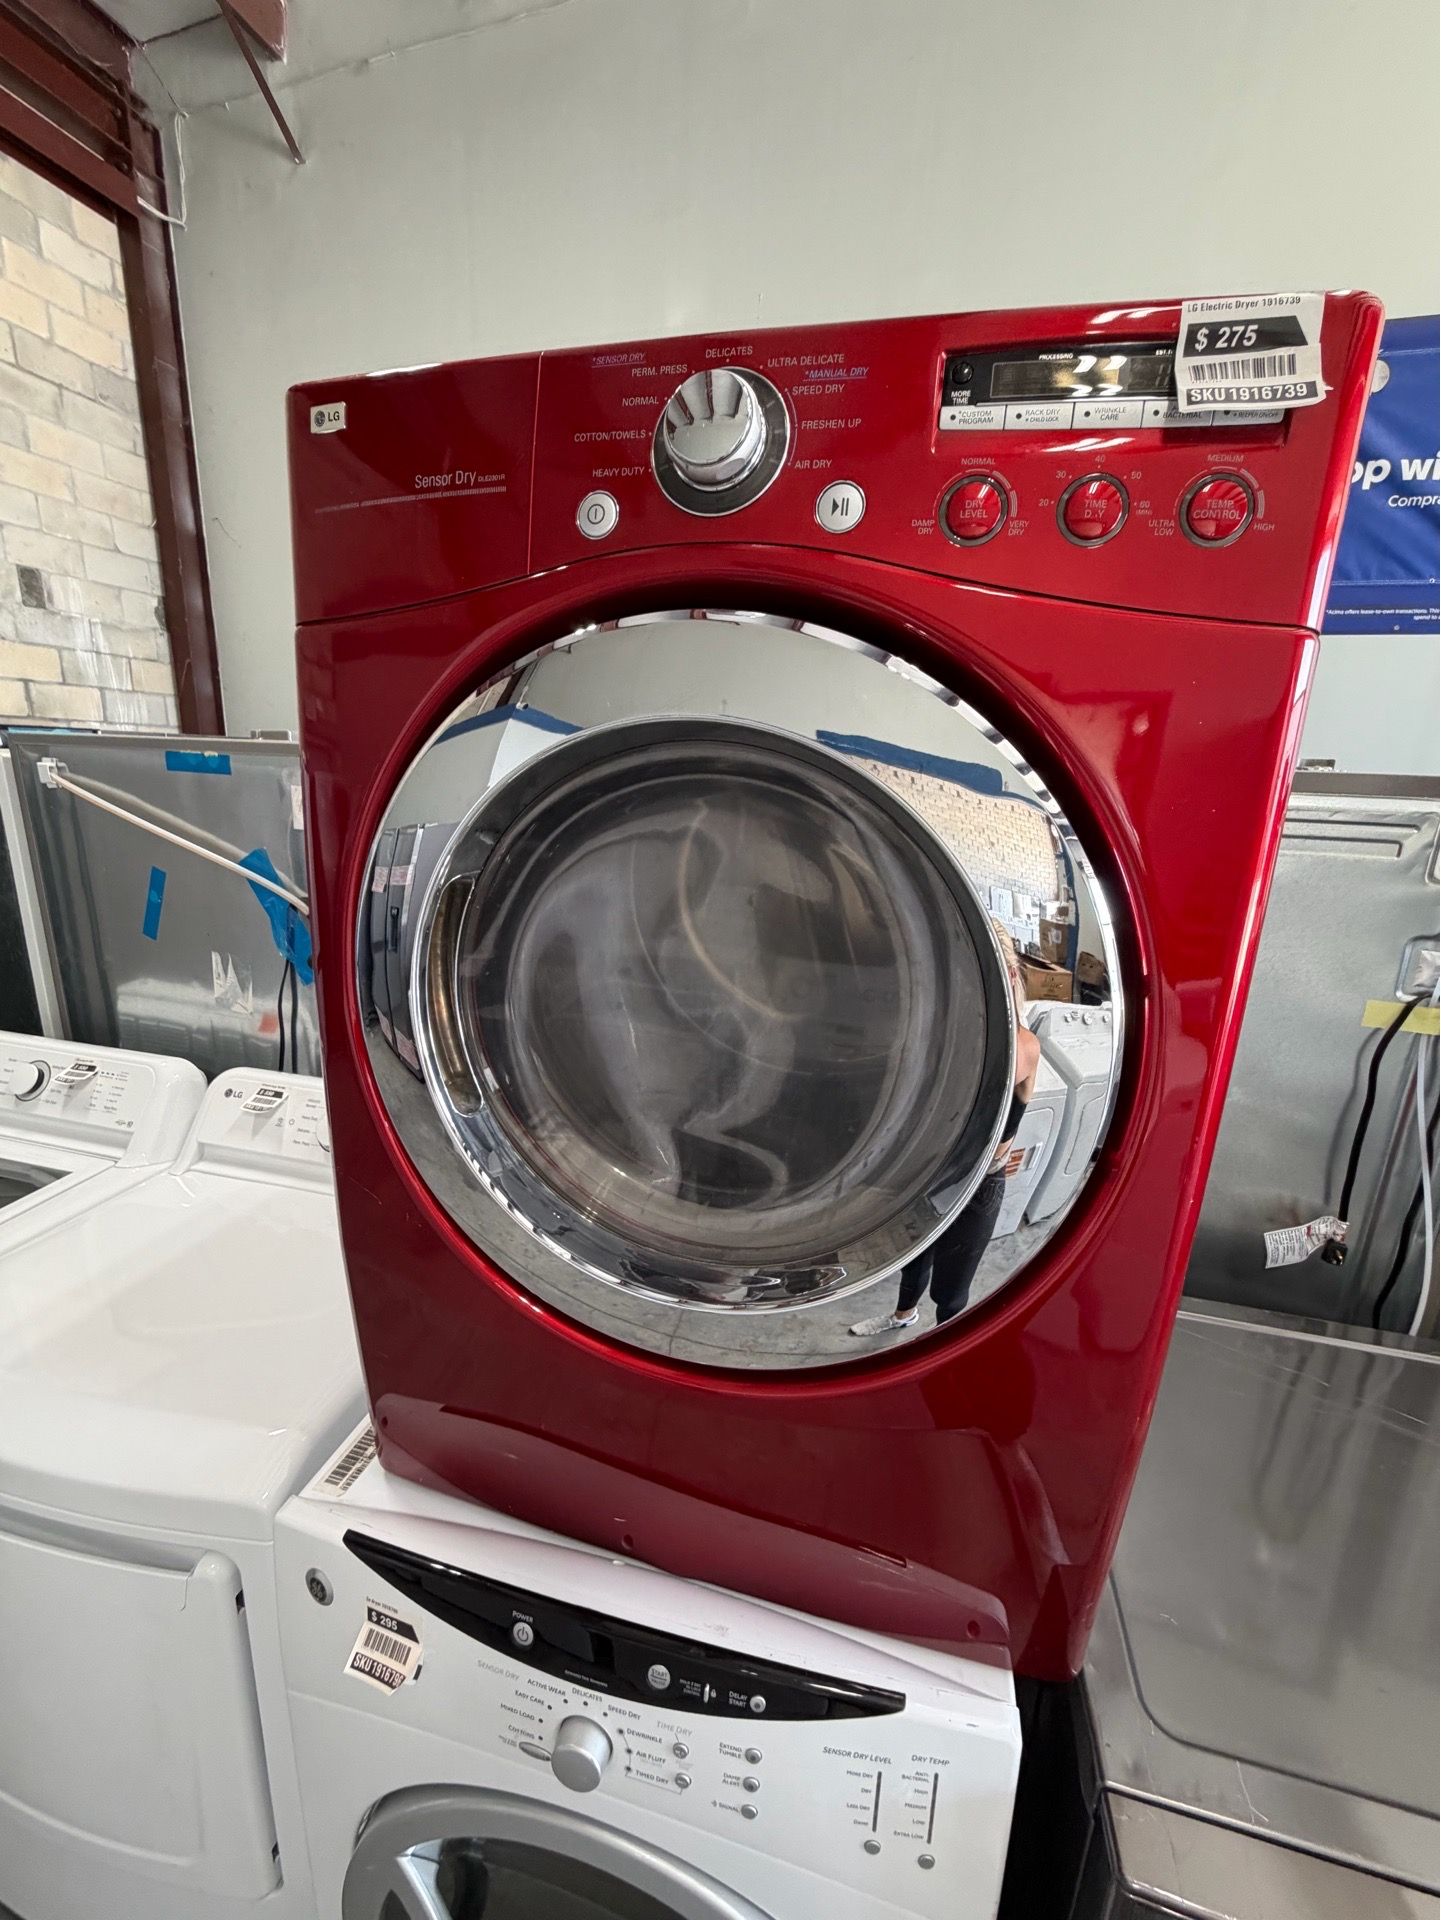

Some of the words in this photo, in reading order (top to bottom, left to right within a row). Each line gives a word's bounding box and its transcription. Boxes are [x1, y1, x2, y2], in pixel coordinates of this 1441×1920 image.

[1187, 303, 1198, 312] LG
[1201, 300, 1233, 311] Electric
[1235, 299, 1259, 310] Dryer
[1195, 326, 1209, 352] $
[1214, 324, 1259, 349] 275
[705, 346, 753, 358] DELICATES
[1039, 352, 1074, 360] PROCESSING
[629, 352, 646, 362] DRY
[768, 357, 797, 367] ULTRA
[800, 354, 845, 365] DELICATE
[631, 366, 658, 377] PERM.
[660, 364, 688, 374] PRESS
[850, 367, 869, 376] DRY
[792, 385, 822, 396] SPEED
[825, 384, 845, 393] DRY
[1190, 388, 1226, 402] SKU
[1229, 383, 1308, 400] 1916739
[622, 397, 659, 406] NORMAL
[328, 411, 340, 421] LG
[1100, 413, 1120, 421] CARE
[801, 419, 845, 430] FRESHEN
[848, 418, 862, 428] UP
[574, 430, 646, 442] COTTON/TOWELS
[961, 457, 996, 465] NORMAL
[1095, 455, 1105, 463] 40
[1207, 454, 1244, 463] MEDIUM
[794, 460, 810, 469] AIR
[813, 459, 832, 469] DRY
[592, 468, 619, 477] HEAVY
[621, 467, 645, 476] DUTY
[1056, 471, 1066, 479] 30
[1131, 471, 1142, 479] 50
[415, 473, 453, 488] Sensor
[455, 470, 477, 487] Dry
[965, 500, 985, 509] DRY
[1039, 499, 1049, 507] 20
[1084, 499, 1108, 508] TIME
[960, 509, 988, 518] LEVEL
[1084, 509, 1105, 518] DY
[1193, 509, 1242, 520] CONTROL
[911, 519, 935, 527] DAMP
[1009, 520, 1030, 528] VERY
[1149, 519, 1175, 528] ULTRA
[1254, 523, 1275, 531] HIGH
[918, 527, 934, 535] DRY
[1008, 528, 1025, 536] DRY
[1154, 528, 1174, 536] LOW
[371, 1610, 377, 1622] $
[380, 1615, 398, 1631] 295
[512, 1610, 534, 1624] POWER
[354, 1653, 373, 1671] SKU
[823, 1746, 852, 1758] SENSOR
[853, 1751, 869, 1760] DRY
[870, 1755, 892, 1765] LEVEL
[911, 1754, 928, 1763] DRY
[929, 1757, 949, 1766] TEMP
